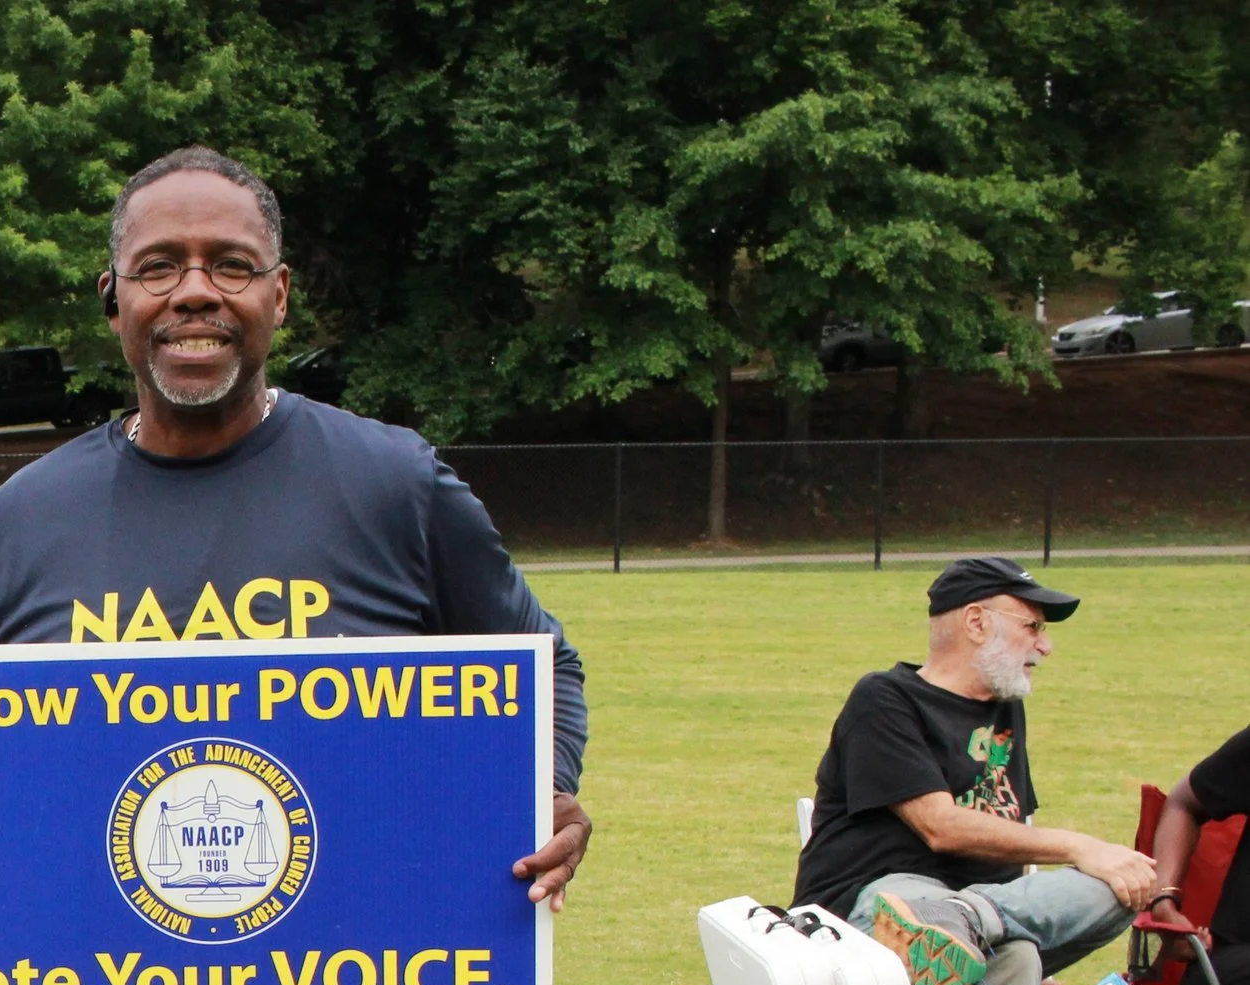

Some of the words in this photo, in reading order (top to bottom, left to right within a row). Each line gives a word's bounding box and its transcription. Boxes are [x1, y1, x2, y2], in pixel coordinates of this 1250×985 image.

[70, 578, 330, 643] NAACP
[92, 672, 240, 724] Your
[259, 664, 519, 721] POWER!
[137, 761, 166, 789] FOR
[167, 746, 196, 769] THE
[204, 744, 298, 802] ADVANCEMENT
[112, 789, 142, 881] ASSOCIATION
[182, 826, 244, 847] NAACP
[288, 808, 308, 826] OF
[198, 859, 229, 872] 1909
[279, 835, 310, 896] COLORED
[130, 885, 192, 935] NATIONAL
[234, 896, 283, 935] PEOPLE
